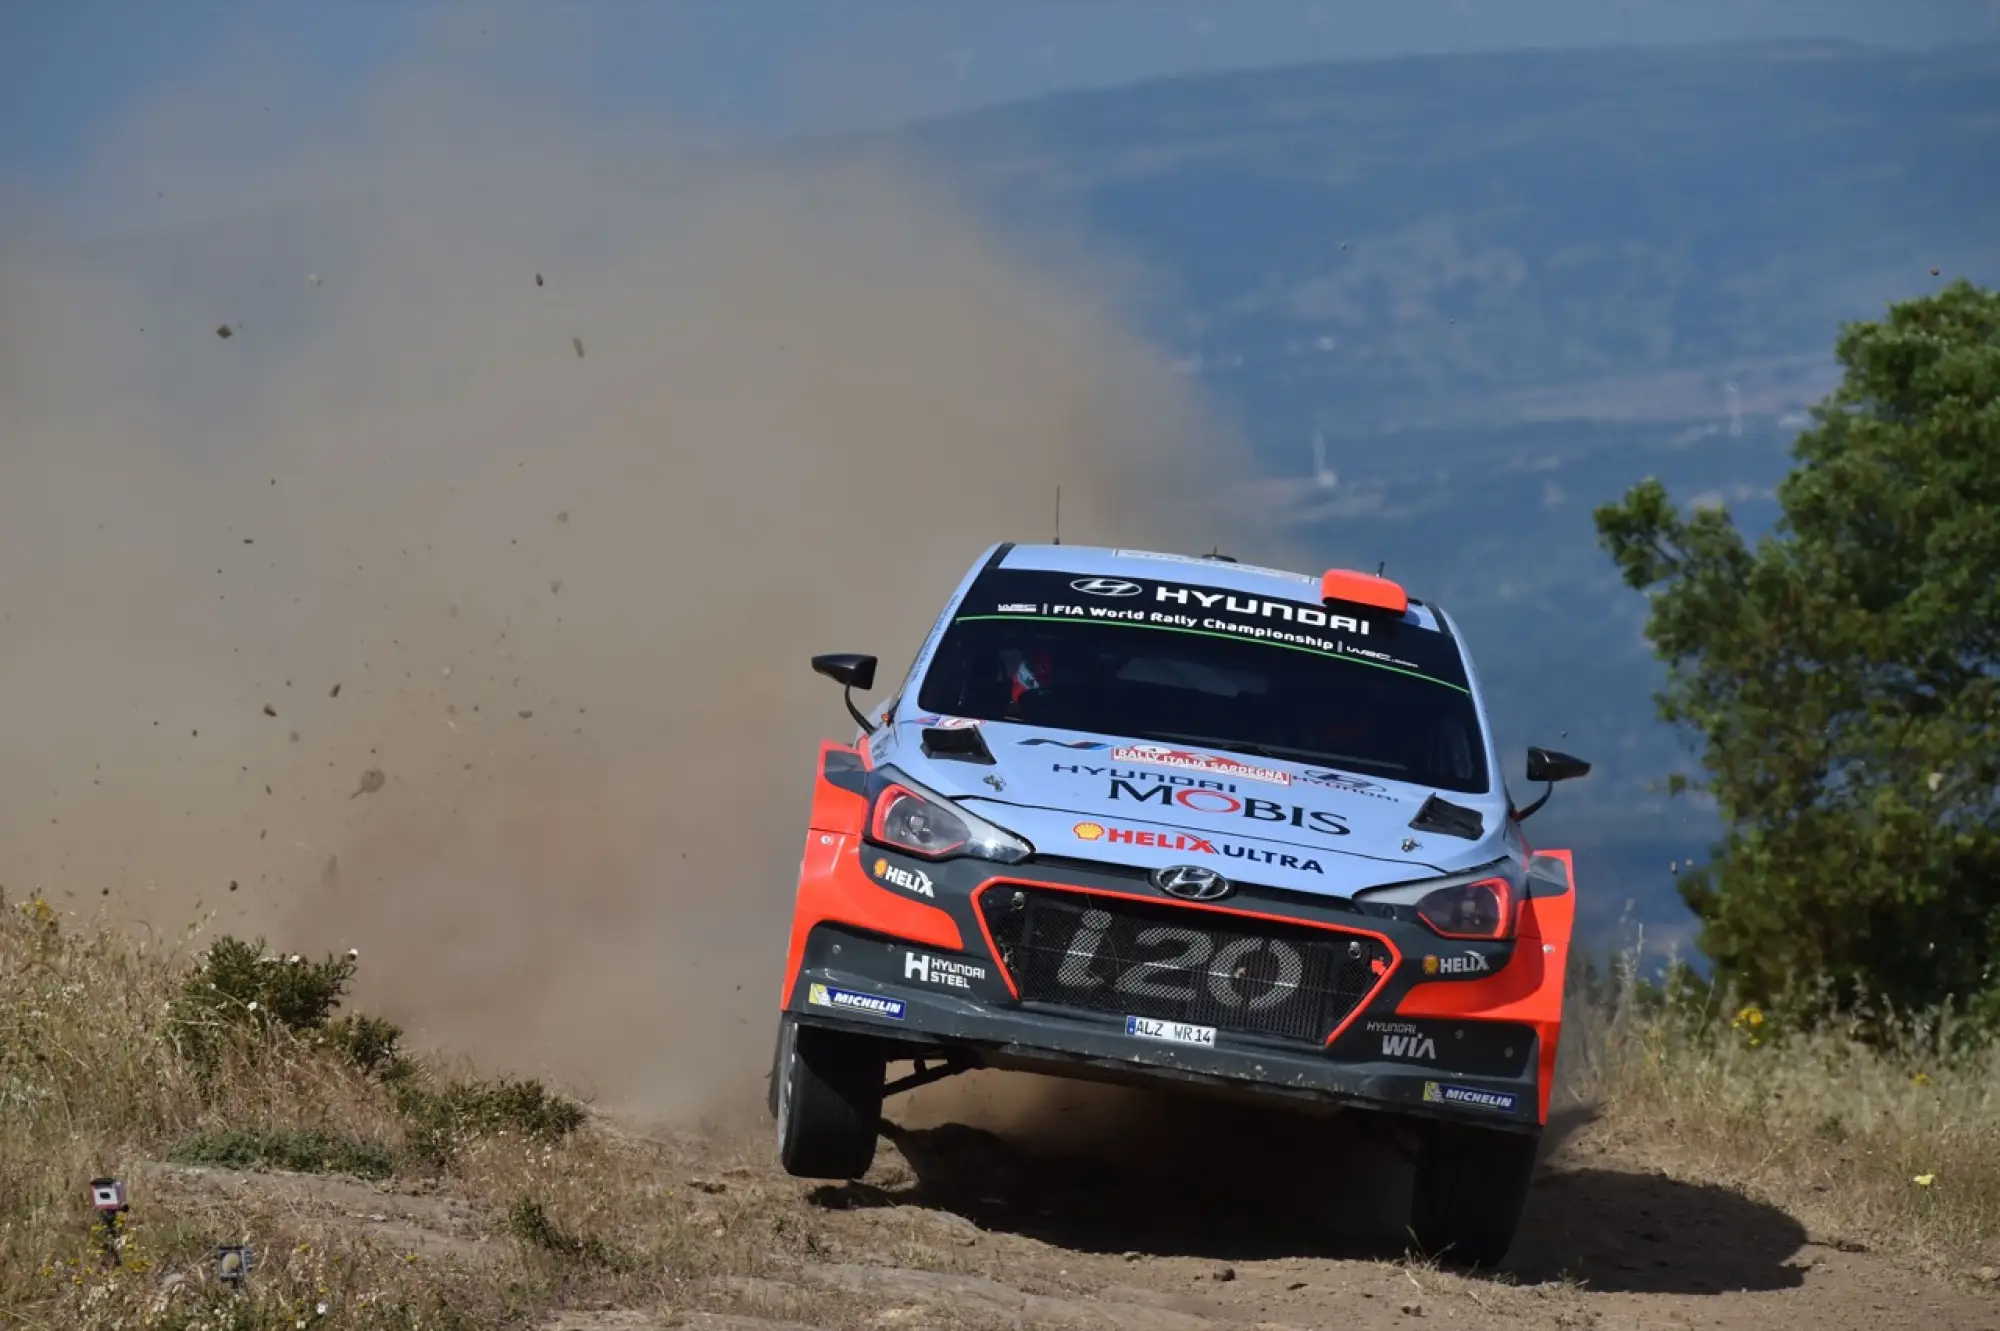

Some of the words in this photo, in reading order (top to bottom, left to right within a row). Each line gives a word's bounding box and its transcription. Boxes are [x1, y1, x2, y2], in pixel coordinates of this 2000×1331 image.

[1155, 586, 1370, 636] HYUNDAI
[1052, 604, 1084, 616] FIA
[1088, 606, 1145, 621] World
[1149, 611, 1198, 628] Rally
[1202, 617, 1334, 651] Championship
[1052, 763, 1237, 793] HYUNDAI
[1118, 747, 1160, 763] RALLY
[1163, 754, 1207, 770] ITALIA
[1210, 761, 1287, 781] SARDEGNA
[1107, 777, 1351, 836] MOBIS
[1107, 827, 1219, 855] HELIX
[1222, 844, 1325, 875] ULTRA
[885, 865, 935, 899] HELIX
[930, 957, 986, 980] HYUNDAI
[1057, 907, 1303, 1012] i20
[1440, 949, 1490, 974] HELIX
[930, 970, 971, 989] STEEL
[833, 991, 901, 1015] MICHELIN
[1136, 1019, 1164, 1037] ALZ
[1366, 1020, 1417, 1035] HYUNDAI
[1445, 1087, 1512, 1108] MICHELIN
